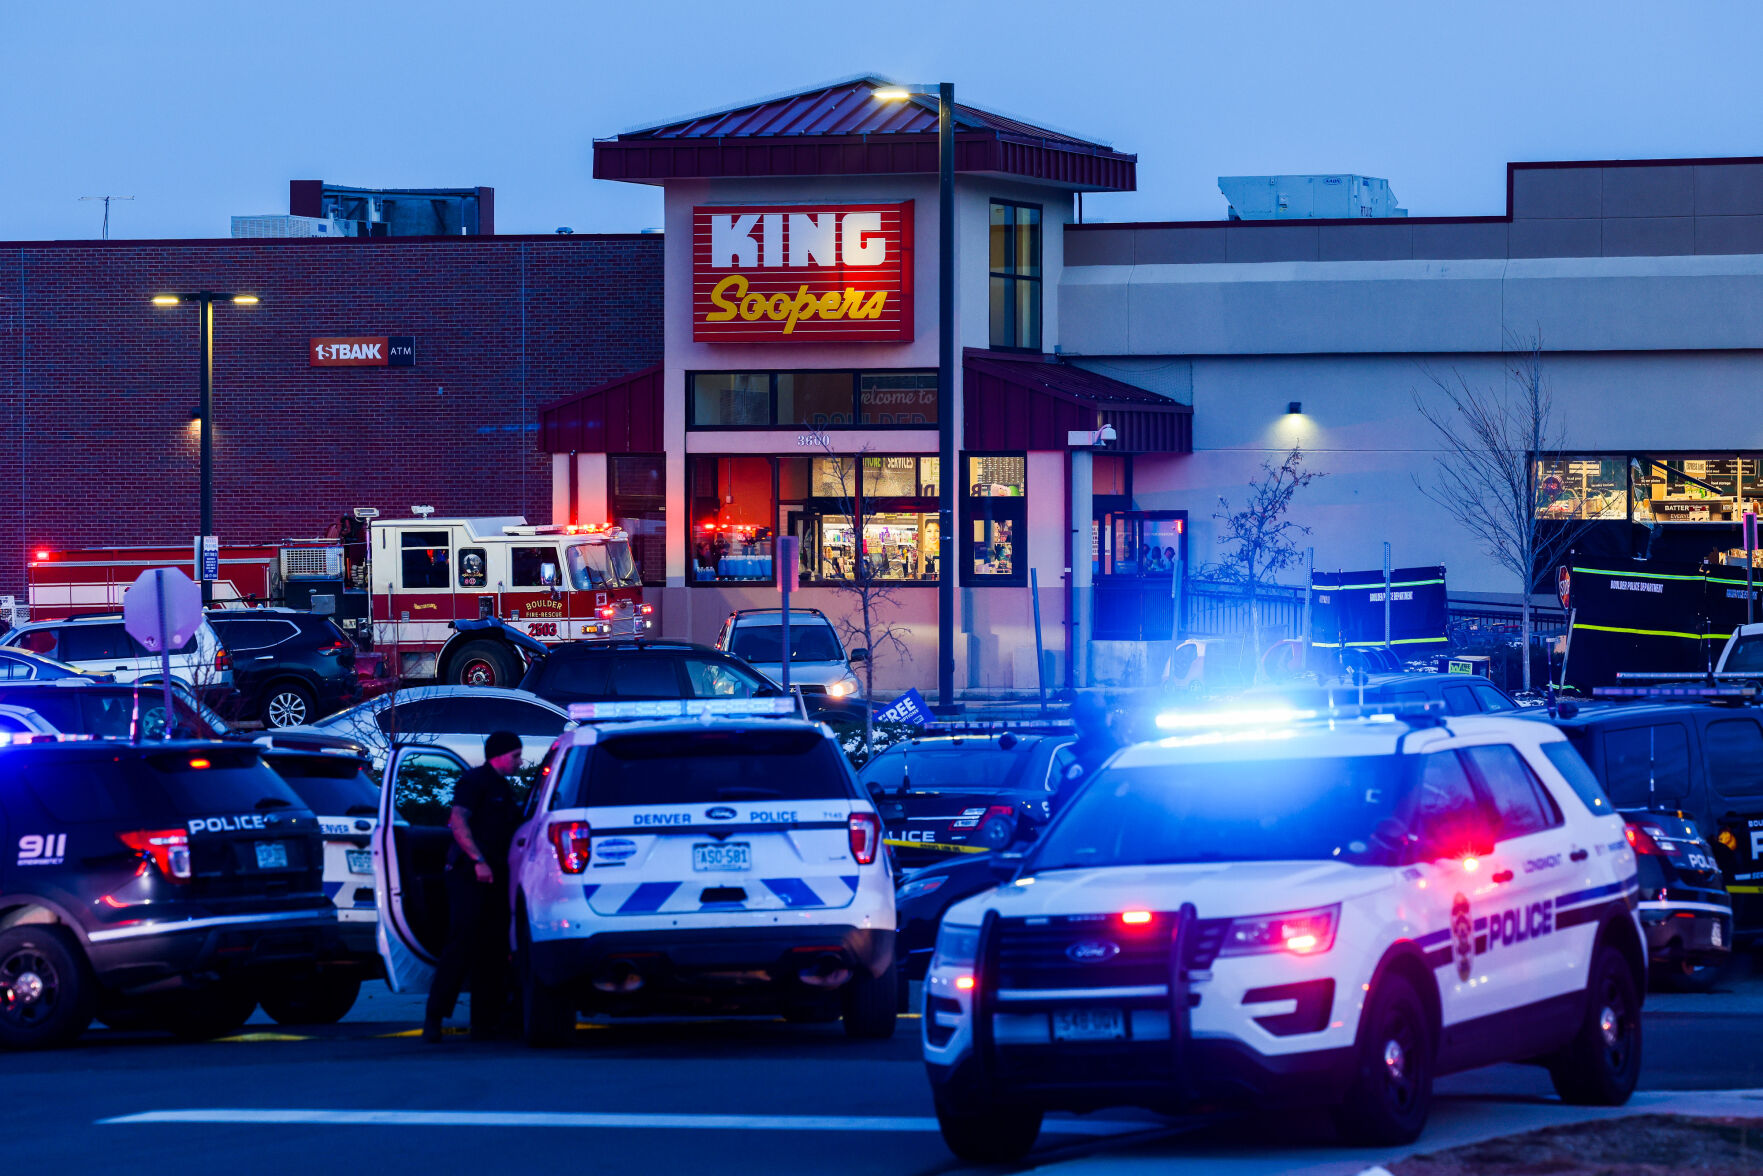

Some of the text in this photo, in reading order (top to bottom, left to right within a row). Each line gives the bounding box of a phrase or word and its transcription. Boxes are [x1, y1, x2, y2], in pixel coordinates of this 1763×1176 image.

[711, 213, 886, 268] KING
[705, 274, 888, 335] Soopers
[390, 346, 412, 356] ATM
[918, 384, 936, 405] to
[797, 434, 830, 447] 3600
[525, 599, 563, 611] BOULDER
[528, 622, 558, 637] 2503
[633, 813, 692, 825] DENVER
[750, 810, 798, 823] POLICE
[187, 815, 267, 835] POLICE
[318, 823, 350, 834] ENVER
[888, 830, 936, 843] LICE
[17, 833, 67, 859] 911
[1490, 899, 1553, 950] POLICE
